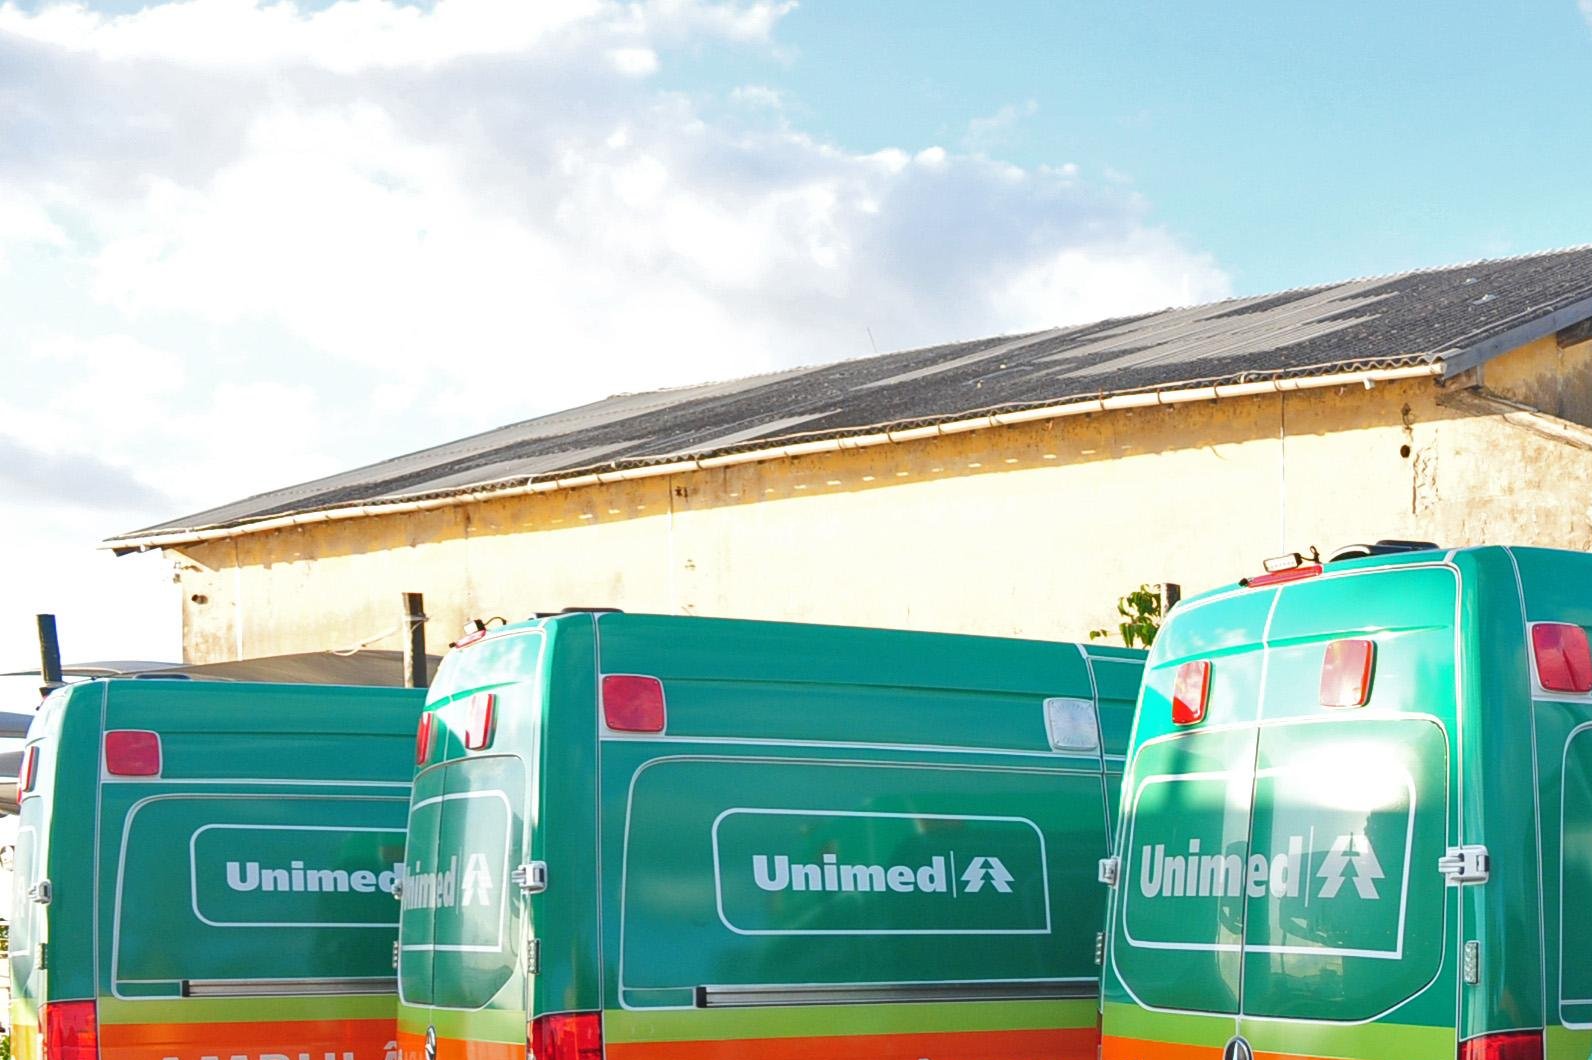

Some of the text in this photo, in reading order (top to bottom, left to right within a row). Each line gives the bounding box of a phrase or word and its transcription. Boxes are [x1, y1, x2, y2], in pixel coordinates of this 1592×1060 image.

[226, 860, 405, 892] Unimed
[753, 853, 947, 892] Unimed
[1140, 836, 1303, 898] Unimed
